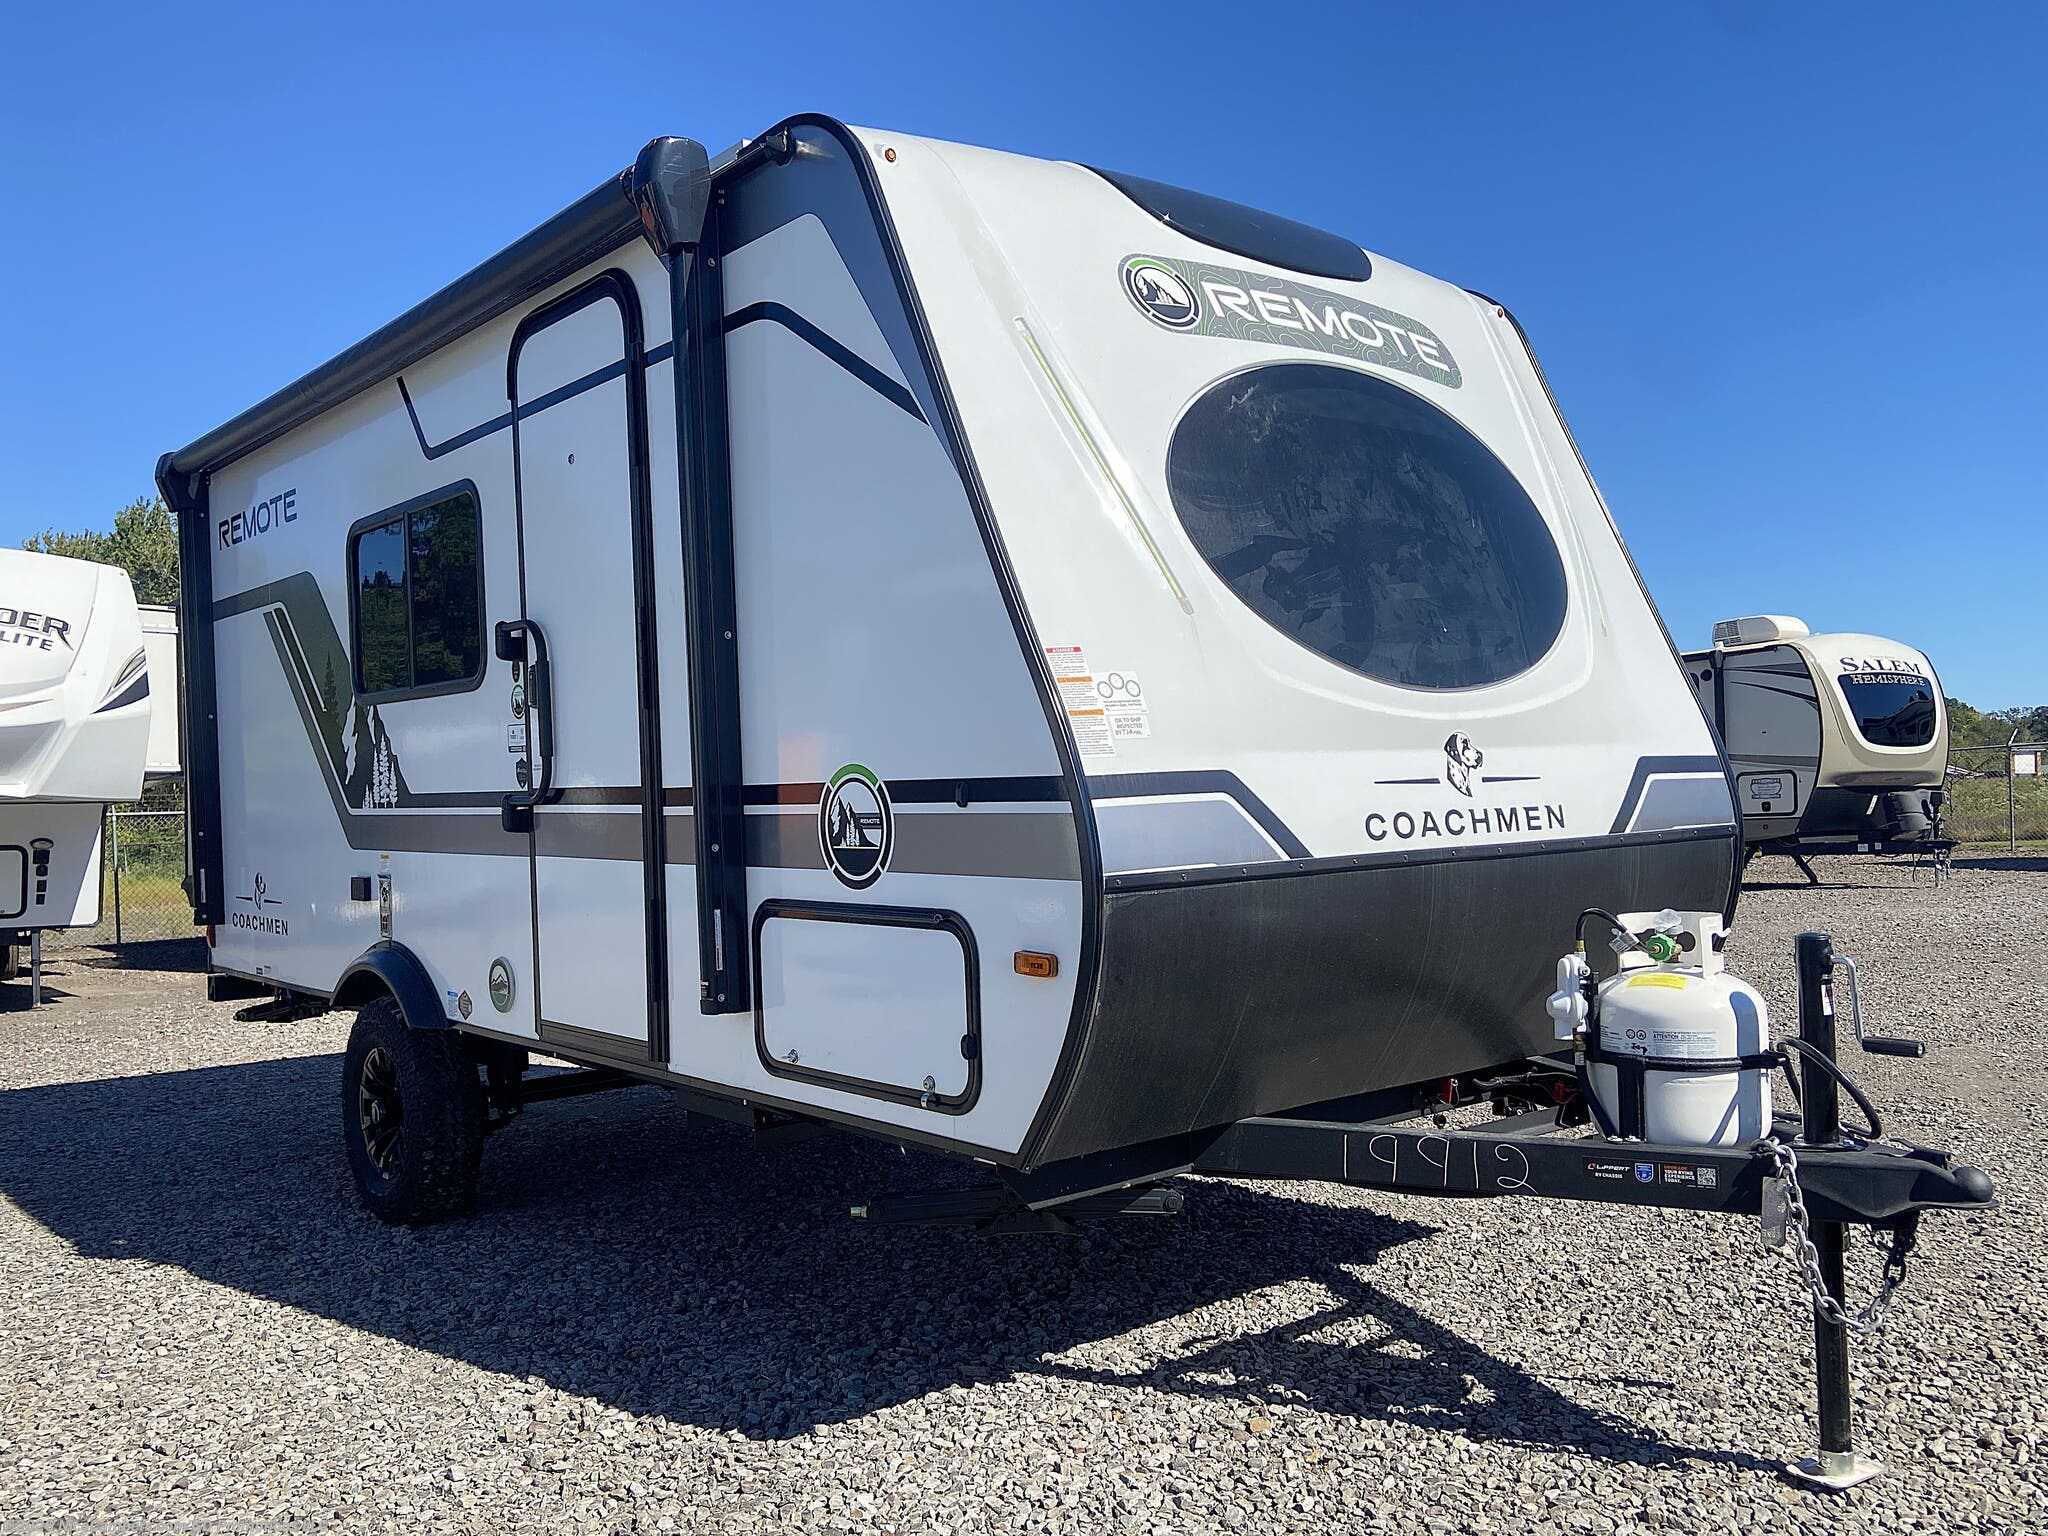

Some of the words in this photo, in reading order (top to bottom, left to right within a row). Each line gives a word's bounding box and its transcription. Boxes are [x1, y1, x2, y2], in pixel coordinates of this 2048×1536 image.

[1200, 281, 1451, 372] REMOTE
[218, 488, 298, 551] REMOTE
[1840, 657, 1923, 675] SALEM
[1850, 674, 1926, 687] HEMISPHERE
[1365, 804, 1566, 841] COACHMEN
[232, 912, 289, 936] COACHMEN
[1343, 1133, 1539, 1195] 19912
